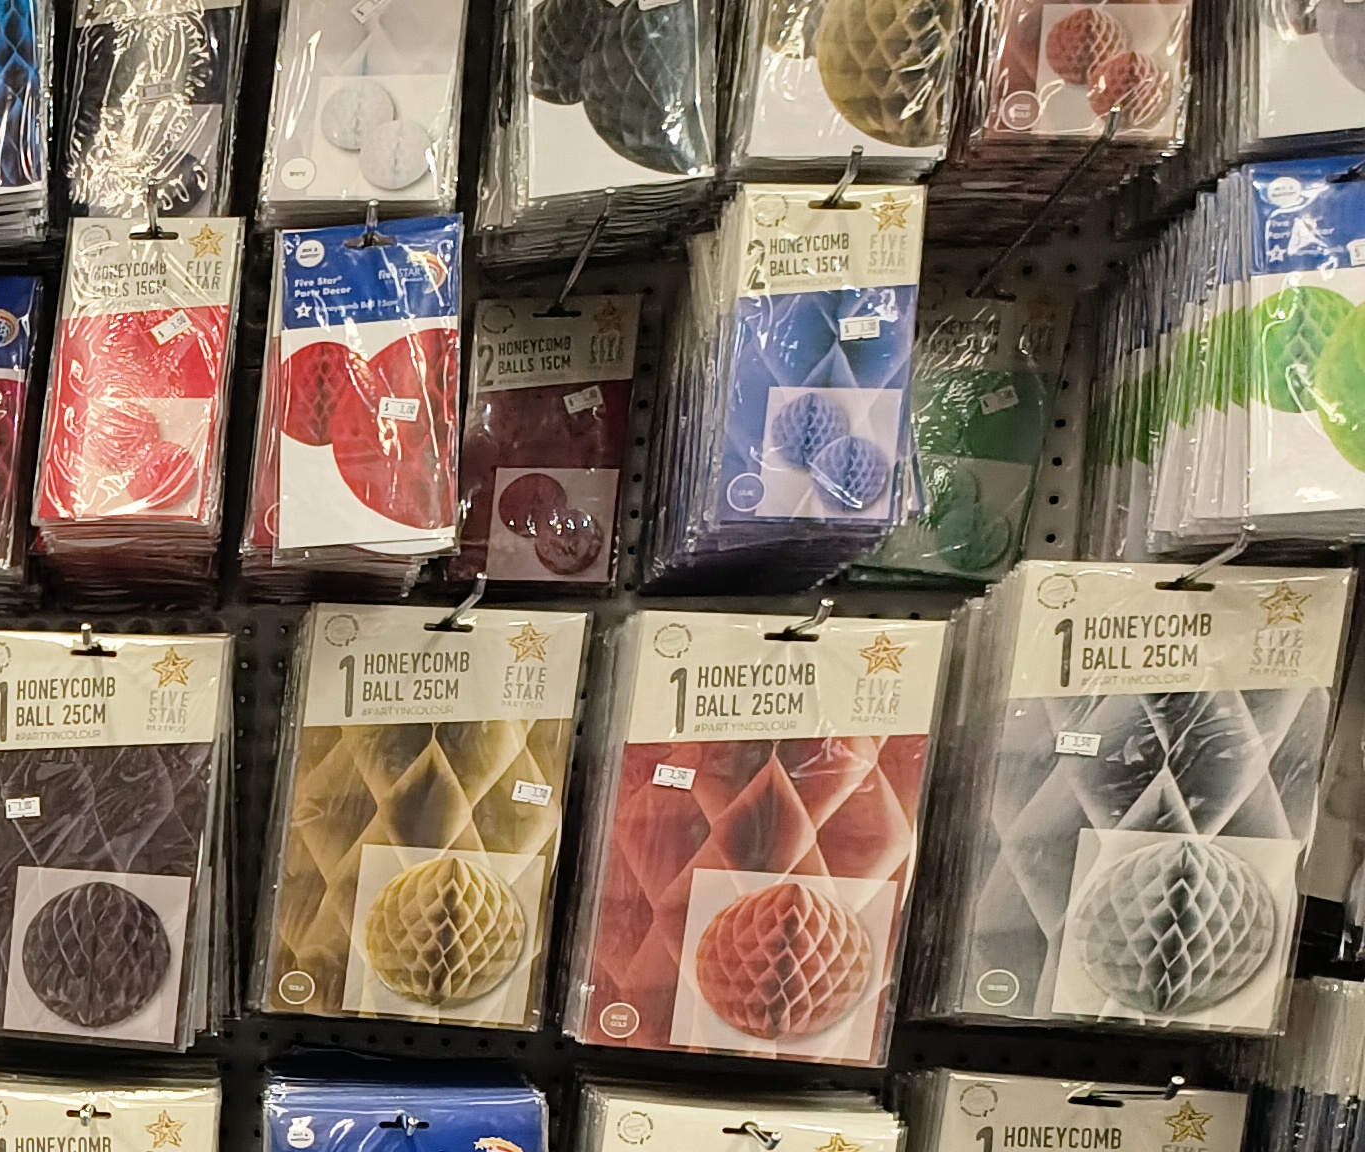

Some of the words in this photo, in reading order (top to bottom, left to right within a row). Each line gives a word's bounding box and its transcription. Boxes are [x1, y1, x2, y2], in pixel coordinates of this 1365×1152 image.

[747, 239, 766, 290] 2
[769, 233, 850, 256] HONEYCOMB
[769, 256, 809, 277] BALLS
[815, 254, 849, 274] 15CM
[1054, 618, 1073, 688] 1
[1084, 613, 1213, 641] HONEYCOMB
[1081, 645, 1133, 670] BALL
[1142, 643, 1198, 668] 25CM
[16, 677, 116, 702] HONEYCOMB
[339, 655, 356, 718] 1
[364, 650, 469, 676] HONEYCOMB
[362, 679, 407, 703] BALL
[414, 677, 460, 702] 25CM
[149, 690, 189, 709] FIVE
[669, 668, 687, 734] 1
[697, 663, 817, 688] HONEYCOMB
[695, 693, 742, 717] BALL
[752, 691, 805, 715] 25CM
[16, 705, 55, 728] BALL
[62, 703, 107, 726] 25CM
[148, 707, 188, 726] STAR
